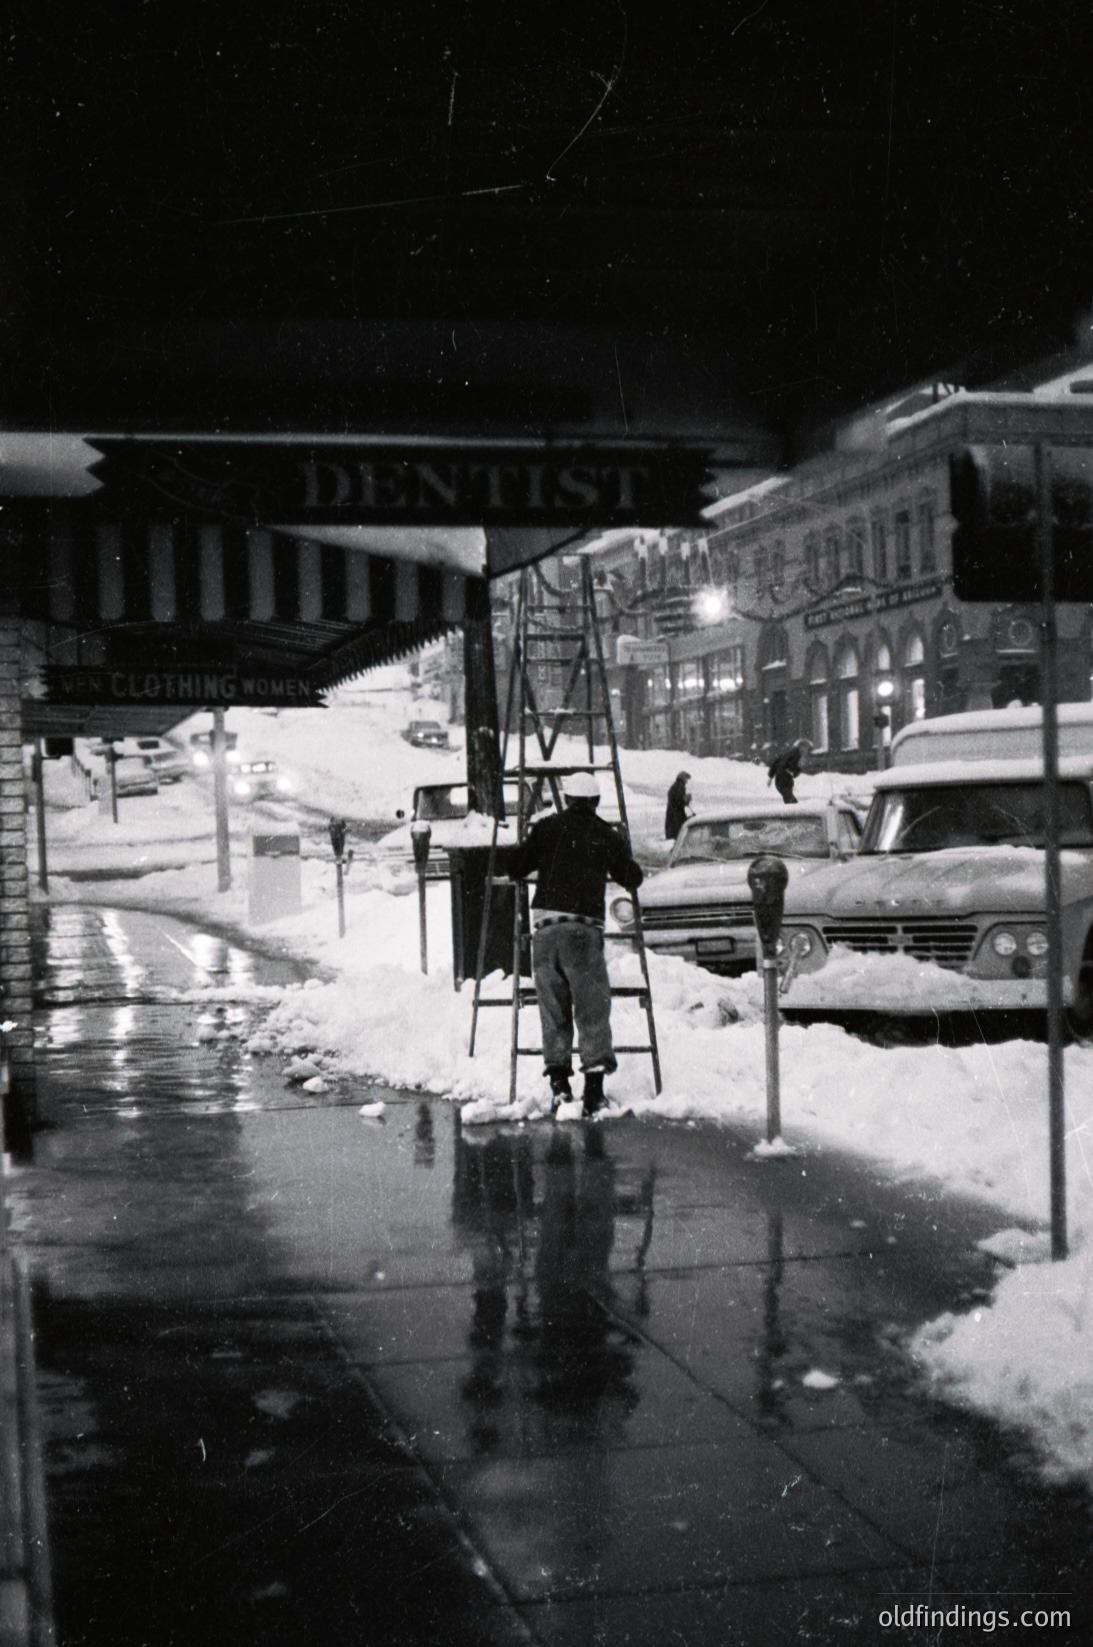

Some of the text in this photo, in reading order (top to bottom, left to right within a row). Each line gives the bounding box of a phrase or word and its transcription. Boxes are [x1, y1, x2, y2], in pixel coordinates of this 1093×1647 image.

[297, 461, 651, 509] DENTIST
[61, 673, 311, 698] MEN CLOTHING WOMEN
